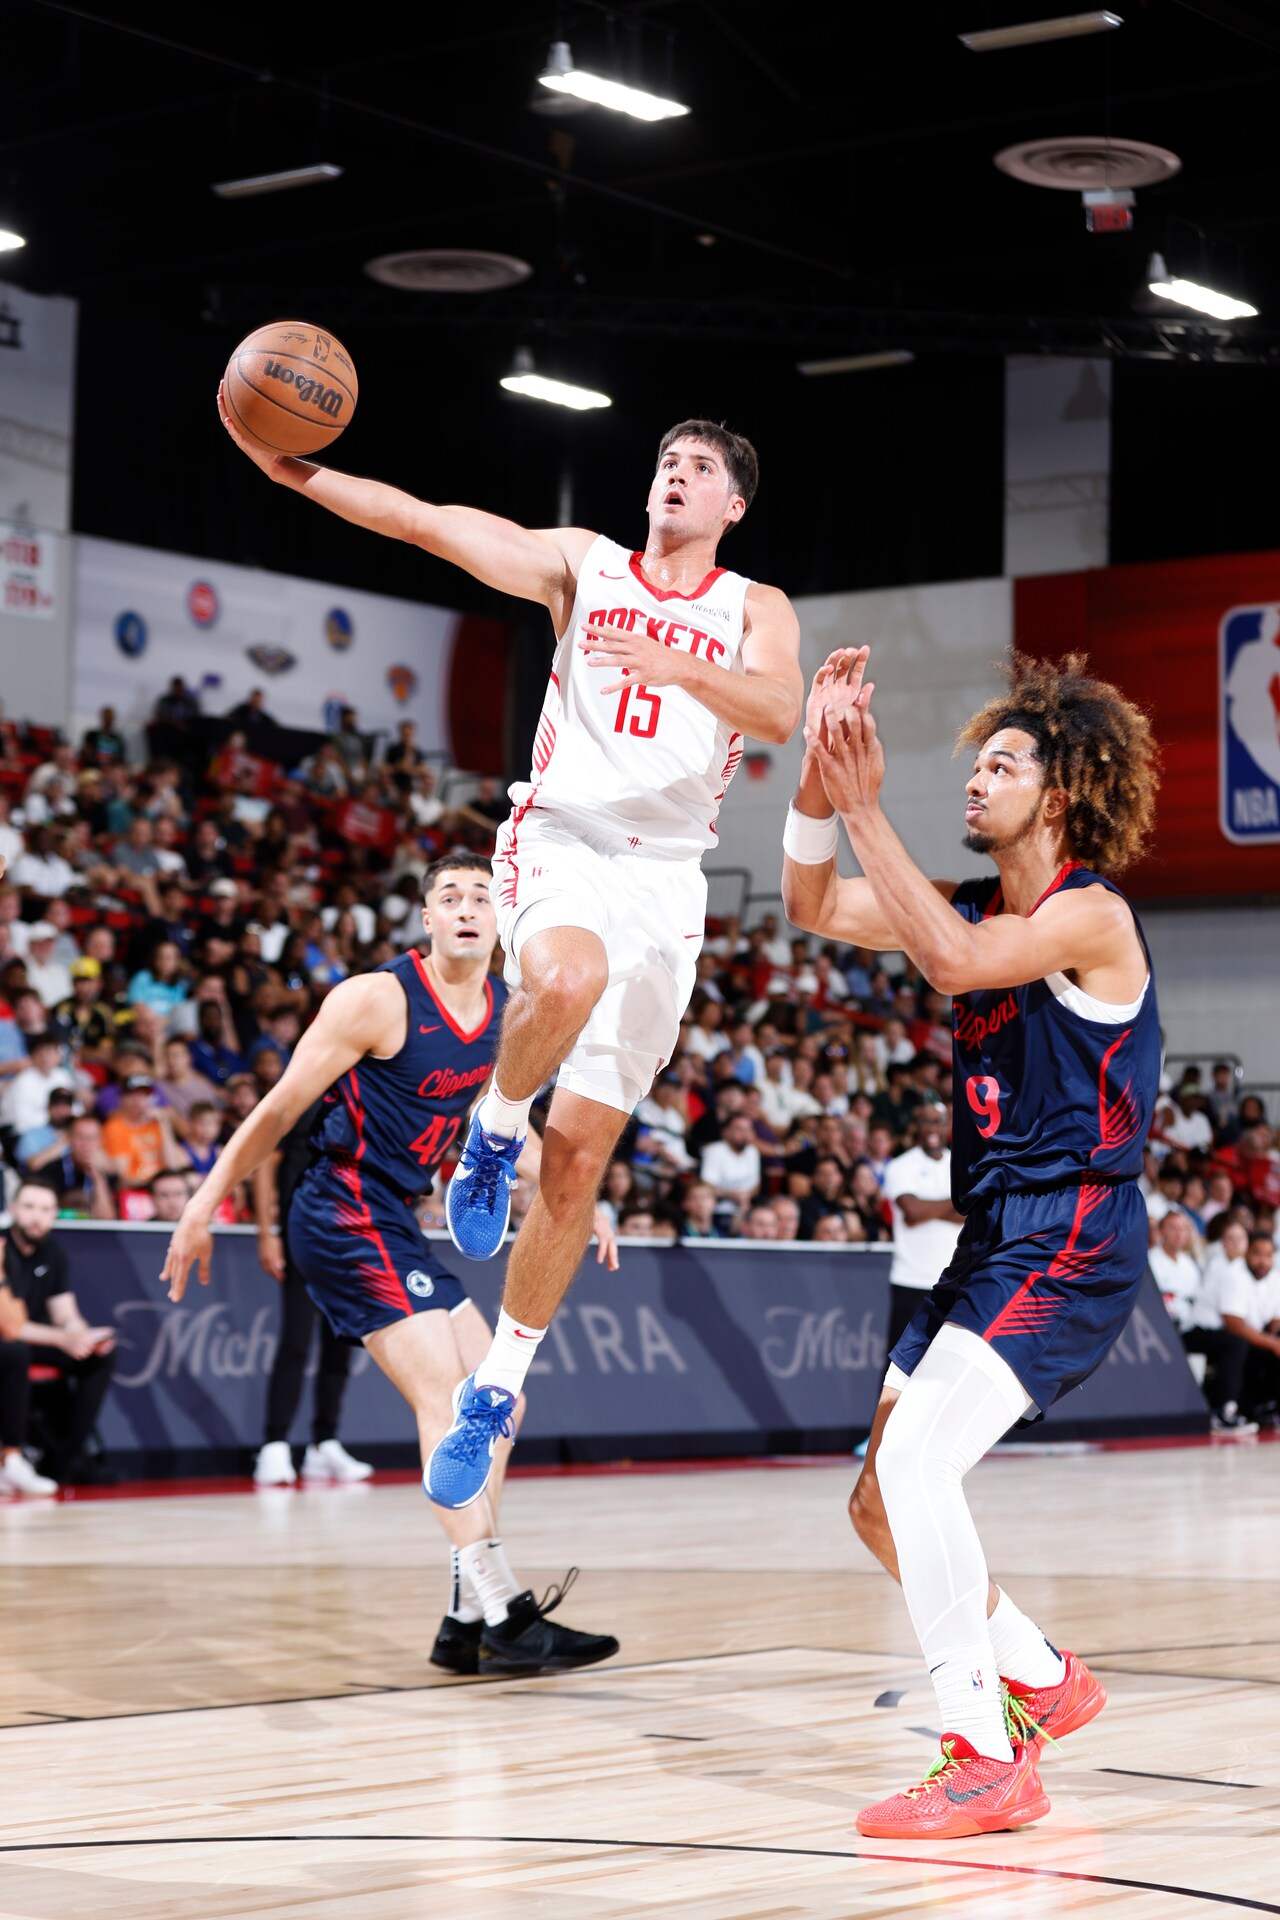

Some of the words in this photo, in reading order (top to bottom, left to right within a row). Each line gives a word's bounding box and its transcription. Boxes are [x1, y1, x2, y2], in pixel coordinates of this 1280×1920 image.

[263, 360, 344, 419] Wilson
[614, 668, 662, 739] 15
[1233, 787, 1279, 828] NBA
[966, 1075, 1001, 1138] 9
[527, 1304, 689, 1374] TRA
